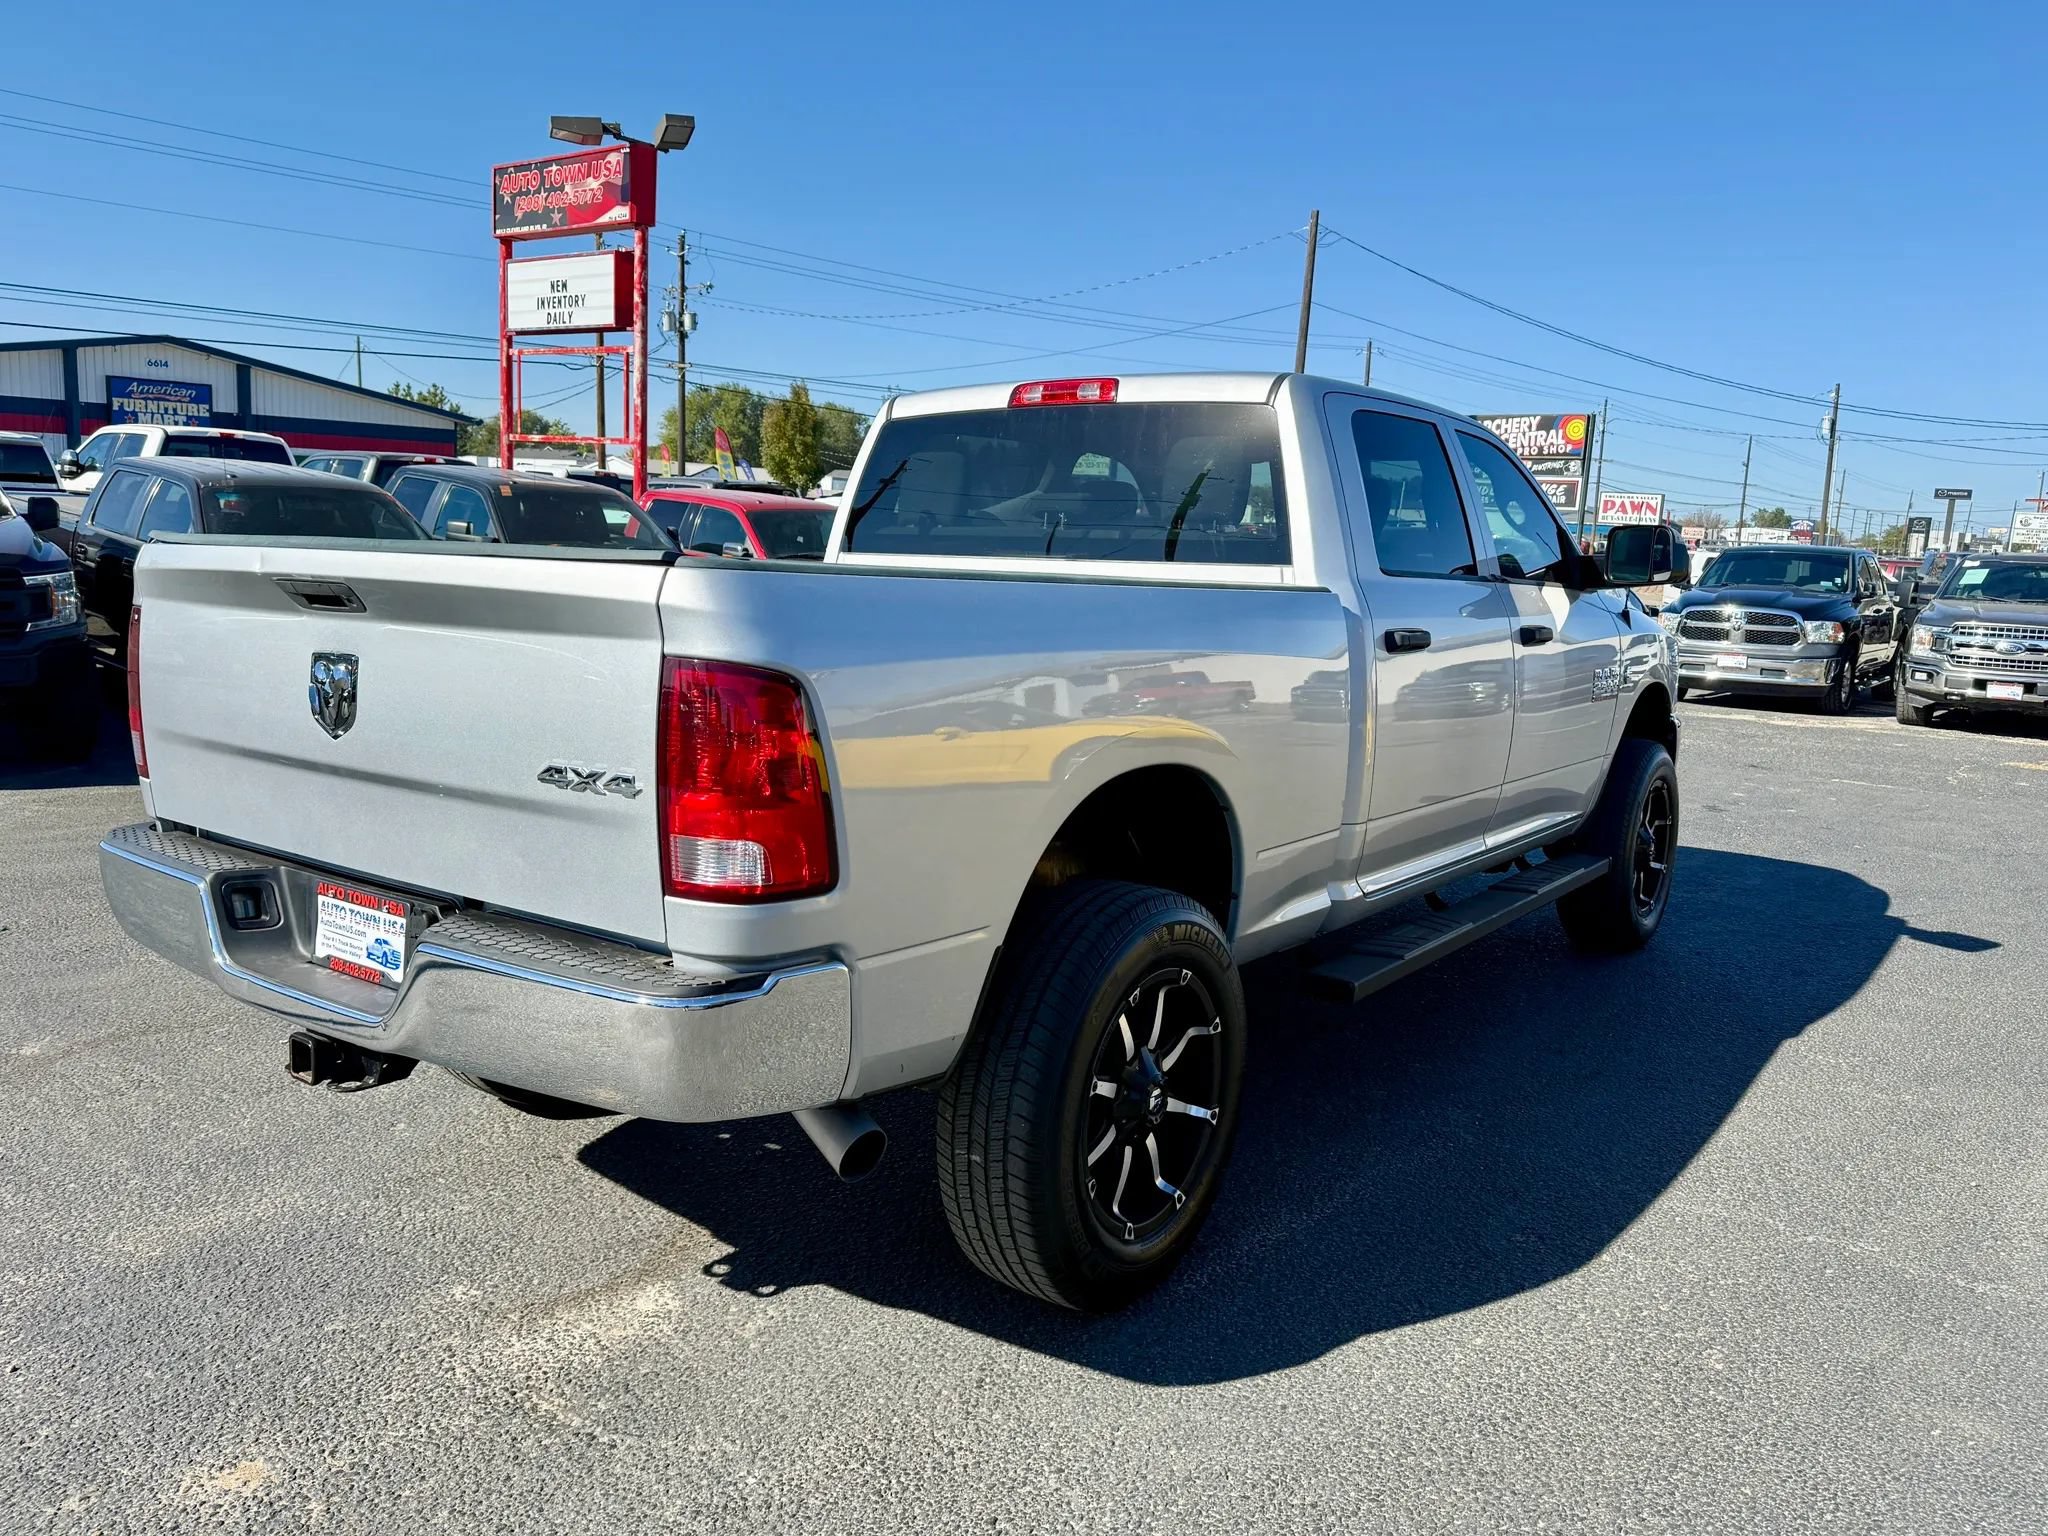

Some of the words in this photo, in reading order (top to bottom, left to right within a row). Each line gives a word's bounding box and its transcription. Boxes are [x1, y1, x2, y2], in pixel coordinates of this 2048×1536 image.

[500, 170, 540, 194] AUTO
[544, 164, 588, 187] TOWN
[591, 158, 623, 181] USA
[514, 193, 544, 215] (208)
[546, 185, 604, 209] 402-5772
[550, 279, 568, 293] NEW
[537, 294, 587, 310] INVENTORY
[546, 311, 574, 325] DAILY
[147, 359, 169, 368] 6614
[125, 381, 196, 398] American
[112, 397, 210, 417] FURNITURE
[138, 412, 187, 426] MART
[1478, 416, 1541, 434] RCHERY
[1501, 428, 1566, 449] CENTRAL
[1517, 446, 1538, 456] PRO
[1543, 444, 1572, 455] SHOP
[1602, 500, 1658, 516] PAWN
[317, 883, 345, 899] AUTO
[347, 890, 379, 910] TOWN
[382, 899, 405, 917] USA
[1174, 924, 1231, 968] MICHELIN
